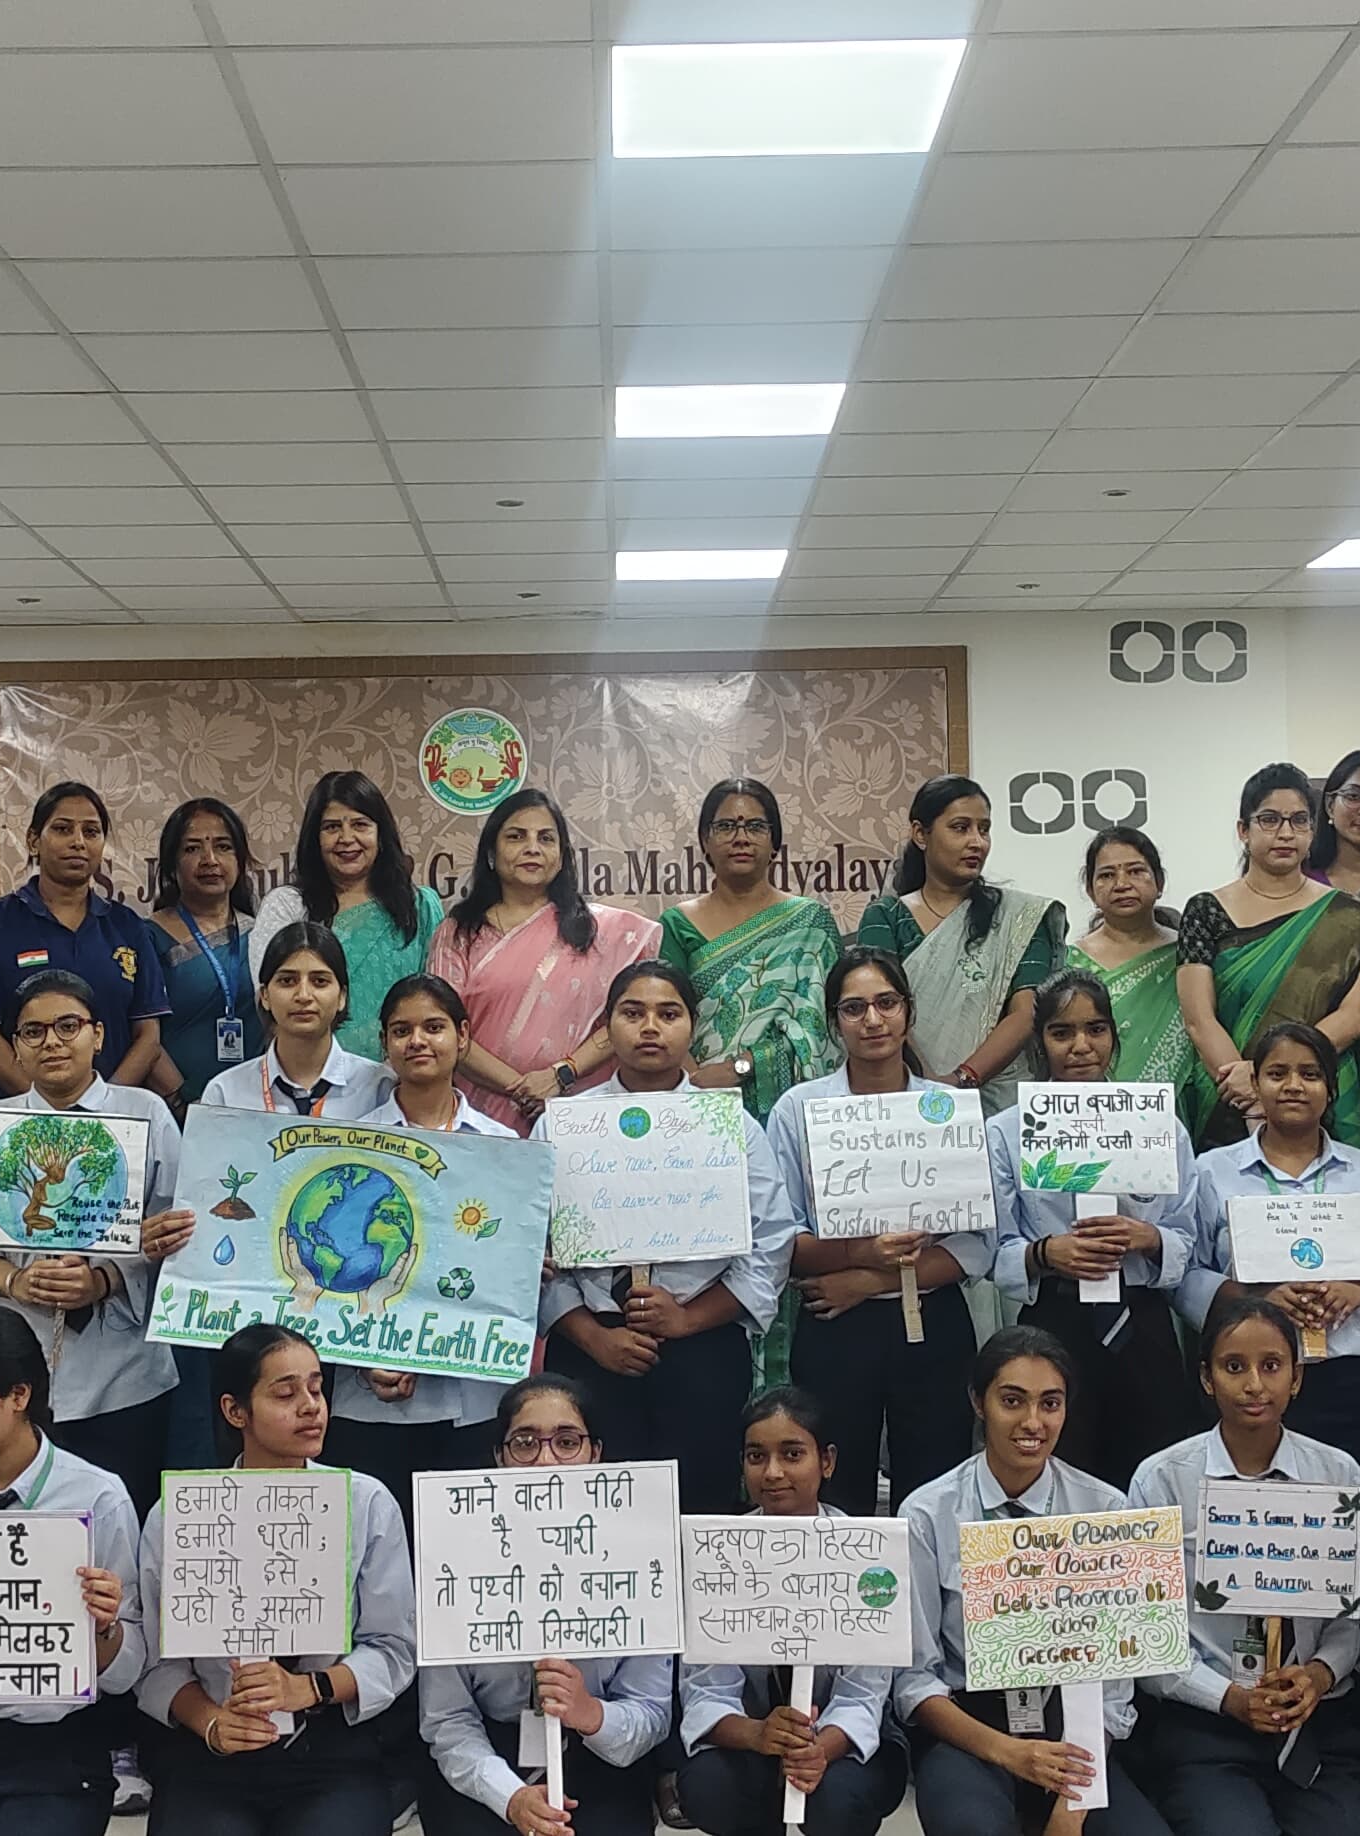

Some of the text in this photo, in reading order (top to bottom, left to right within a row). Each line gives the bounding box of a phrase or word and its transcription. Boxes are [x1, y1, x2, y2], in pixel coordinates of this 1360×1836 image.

[287, 1129, 312, 1146] Our
[347, 1133, 371, 1150] Our
[373, 1135, 408, 1155] Planet
[829, 1127, 927, 1151] Sustains
[822, 1158, 872, 1197] Let
[184, 1289, 240, 1331] Plant
[328, 1305, 378, 1349] Set
[379, 1311, 412, 1352] the
[417, 1312, 477, 1364] Earth
[481, 1319, 530, 1366] Free
[175, 1476, 244, 1514] हमारी
[446, 1476, 498, 1515] आने
[514, 1474, 564, 1511] वाली
[175, 1513, 237, 1550] हमारी
[492, 1514, 513, 1558] है
[256, 1587, 325, 1624] असली
[435, 1559, 664, 1615] तो पृथ्वी को बचाना है
[467, 1610, 524, 1652] हमारी
